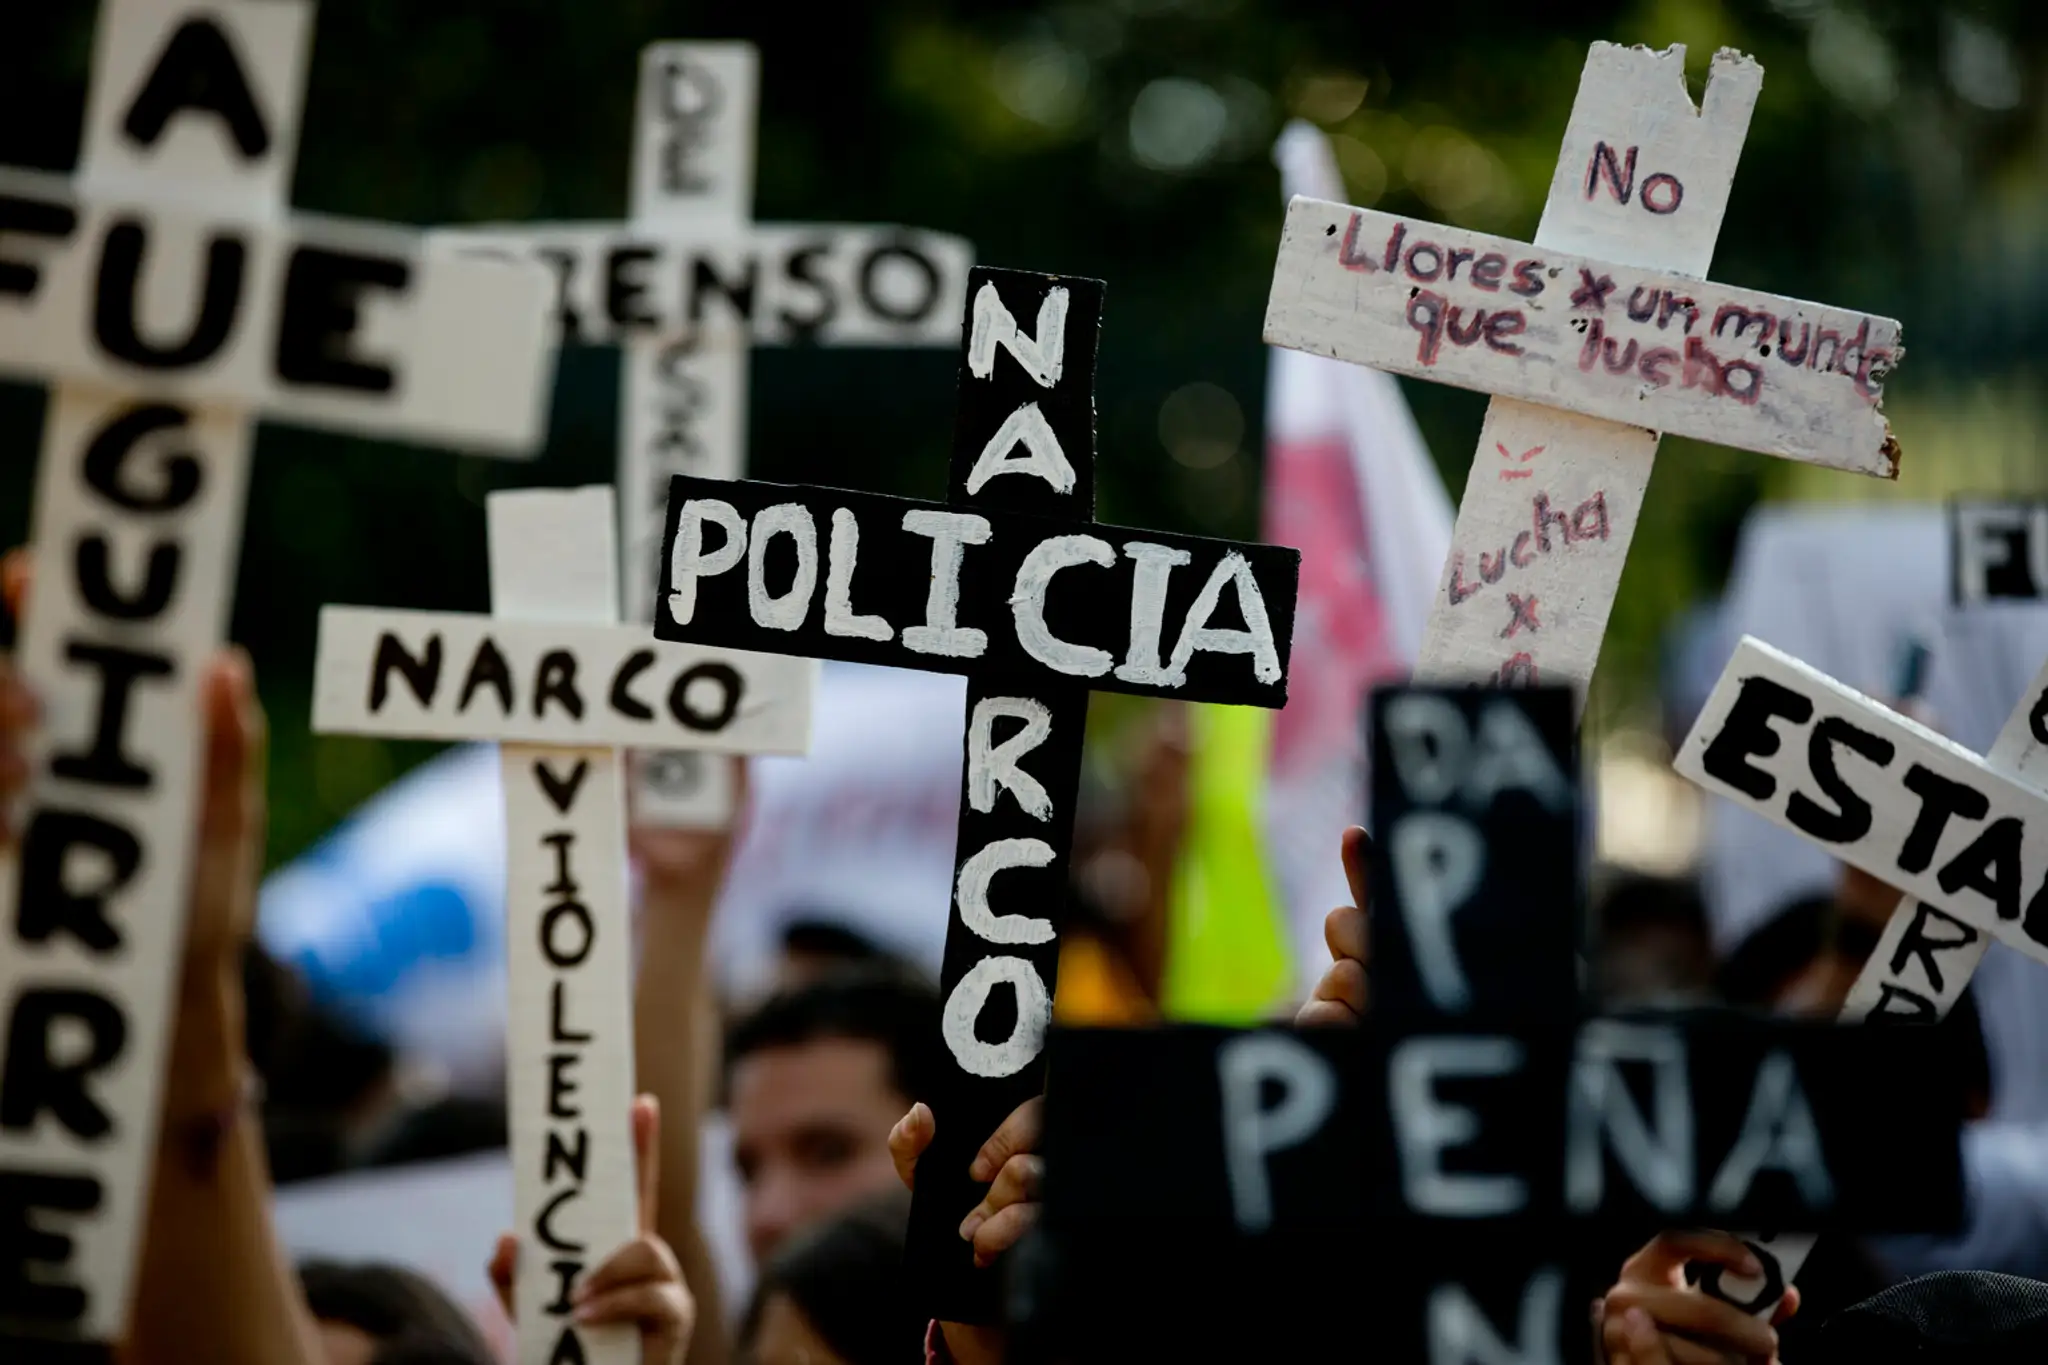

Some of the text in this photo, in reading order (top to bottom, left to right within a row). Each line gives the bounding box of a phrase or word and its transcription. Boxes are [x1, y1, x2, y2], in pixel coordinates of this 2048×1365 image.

[1585, 141, 1685, 214] No
[1338, 212, 1545, 298] Llores
[1627, 285, 1700, 335] un
[1406, 288, 1527, 367] que
[668, 498, 1282, 688] POLICIA
[1449, 490, 1610, 606] Lucha
[1500, 592, 1541, 639] x
[369, 631, 746, 733] NARCO
[1384, 694, 1573, 808] DA
[533, 757, 595, 1365] VIOLENCIA
